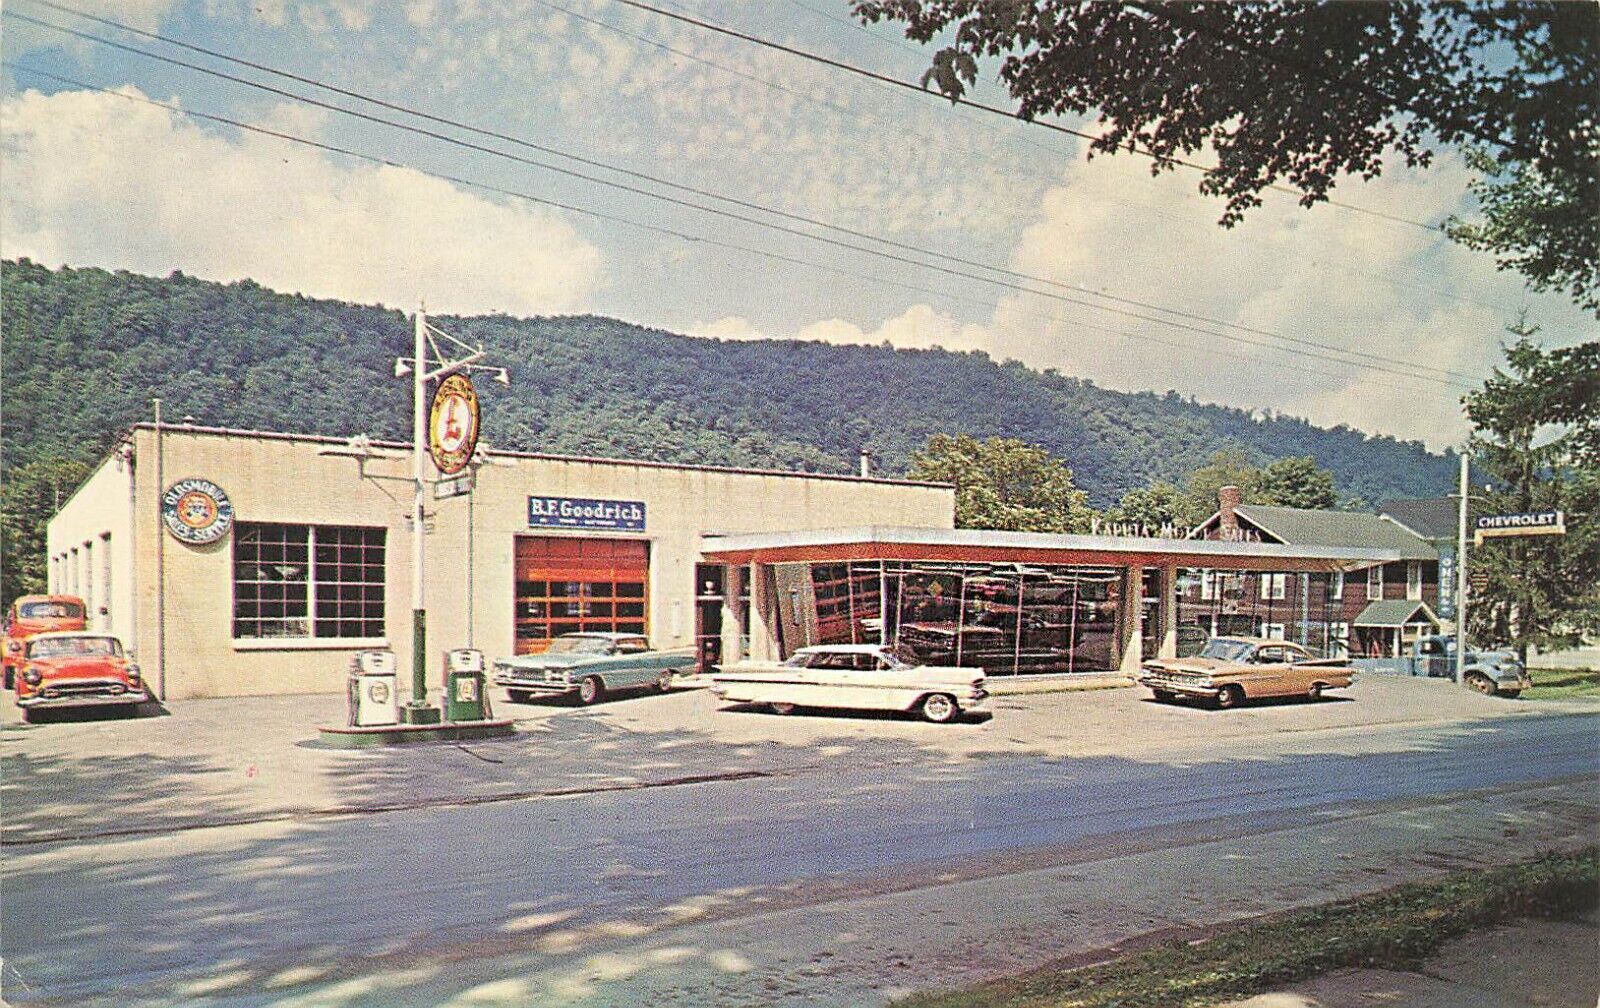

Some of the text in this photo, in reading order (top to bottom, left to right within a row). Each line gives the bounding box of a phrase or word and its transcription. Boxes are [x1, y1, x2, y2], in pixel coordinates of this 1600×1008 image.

[164, 480, 231, 506] OLDSMOBILE
[560, 501, 642, 520] Goodrich
[1478, 513, 1555, 528] CHEVROLET
